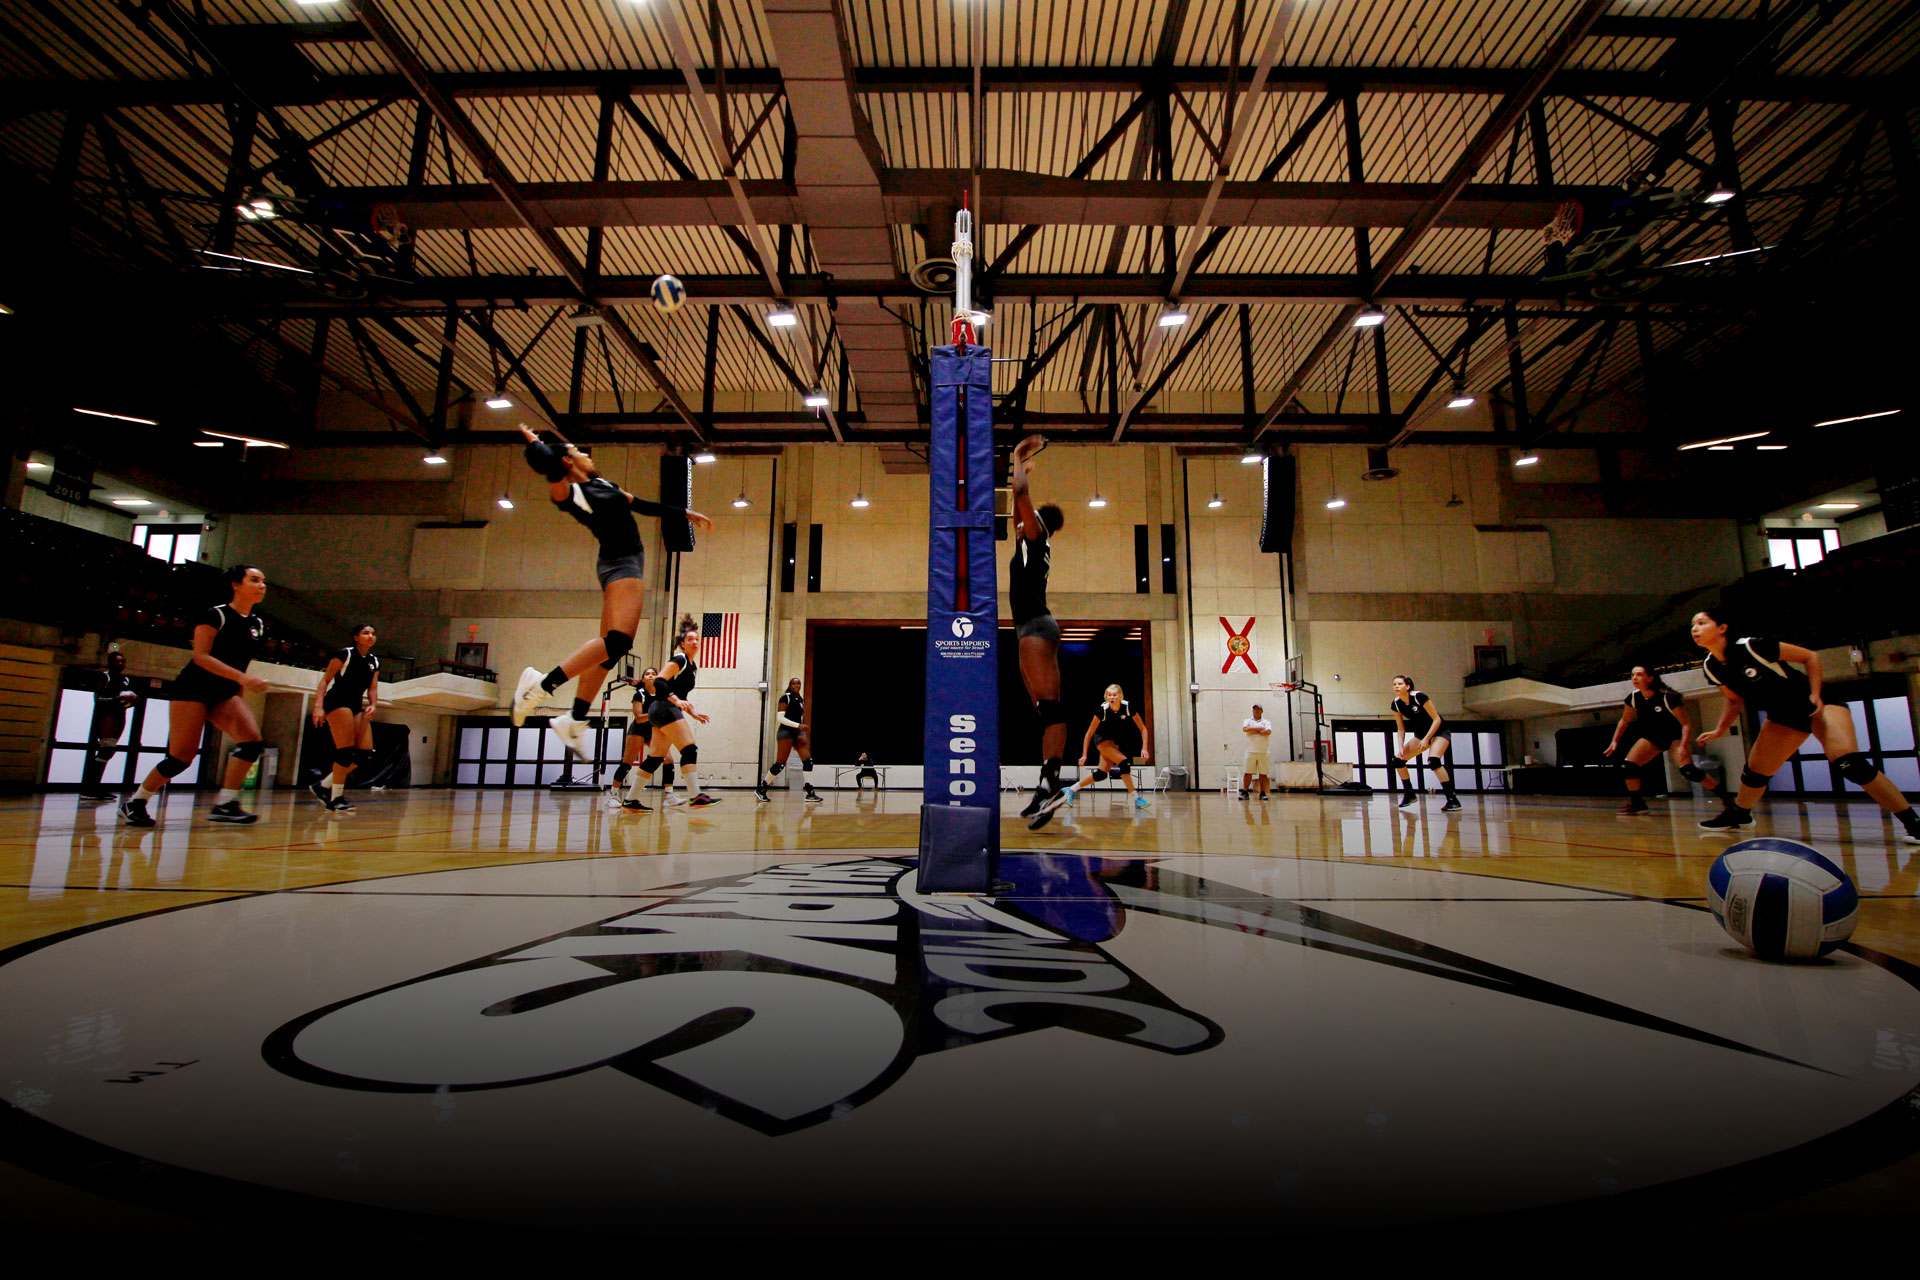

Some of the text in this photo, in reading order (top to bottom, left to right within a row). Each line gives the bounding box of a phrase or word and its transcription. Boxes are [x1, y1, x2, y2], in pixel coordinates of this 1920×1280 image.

[935, 640, 991, 649] SPORTS IMPORTS
[949, 714, 977, 807] seno
[921, 930, 1211, 1052] MDC
